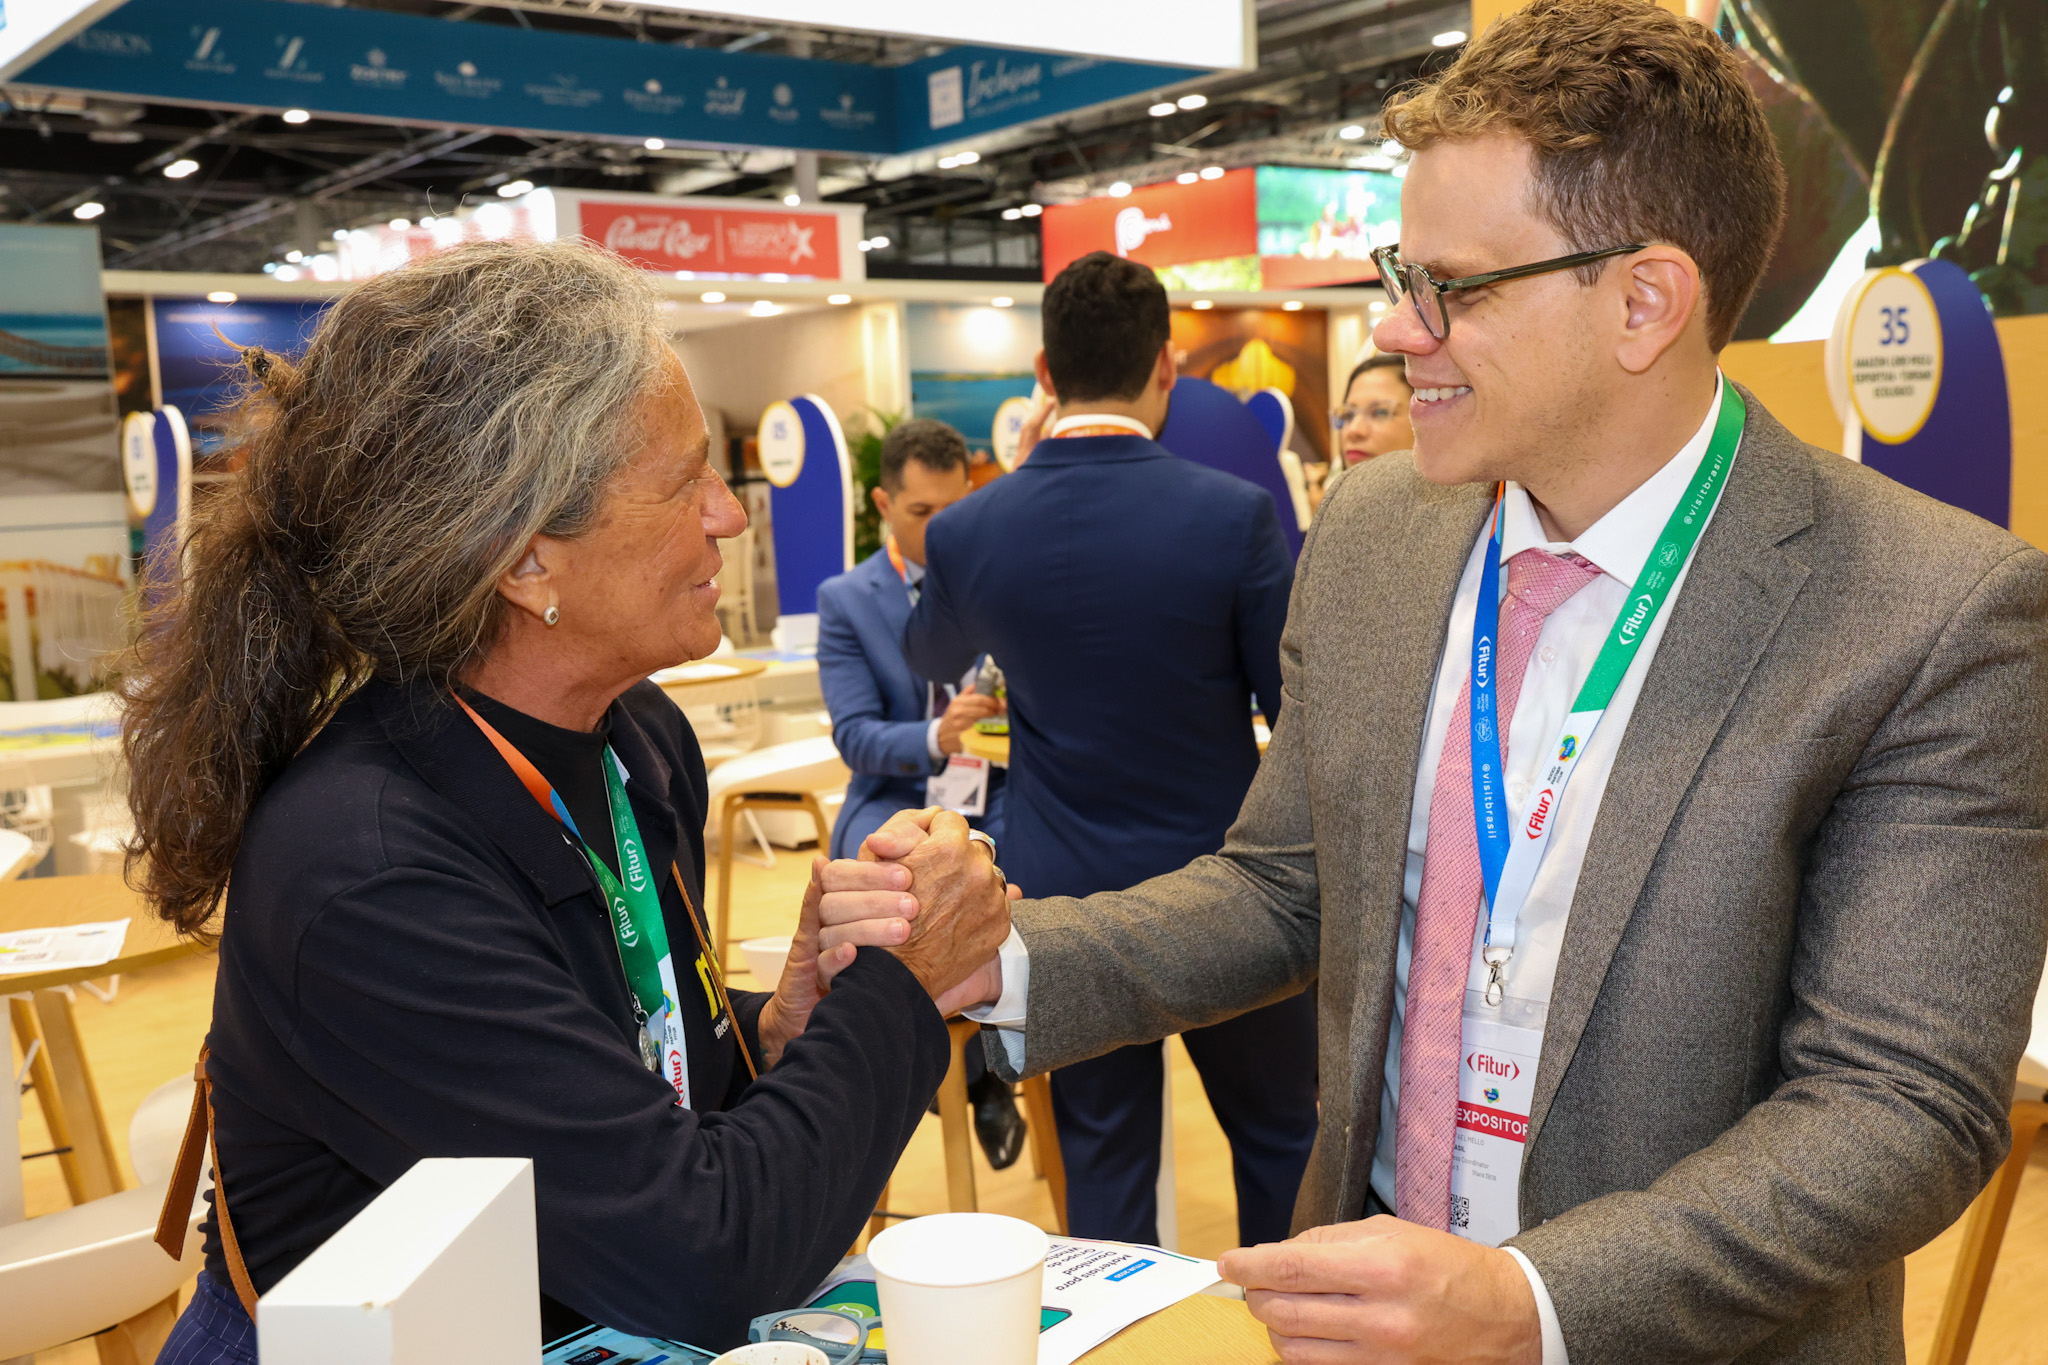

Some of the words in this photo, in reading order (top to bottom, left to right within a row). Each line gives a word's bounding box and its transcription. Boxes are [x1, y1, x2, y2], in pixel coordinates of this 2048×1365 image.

[1880, 307, 1909, 345] 35
[1683, 454, 1724, 525] @visitbrasil
[1564, 741, 1574, 756] BRASIL
[1551, 766, 1562, 785] PARTNER
[1482, 763, 1498, 839] @visitbrasil
[1468, 1135, 1485, 1147] MELLO
[1461, 1156, 1490, 1170] Coordinator
[1472, 1170, 1485, 1179] Stand
[1061, 1251, 1117, 1276] Download
[1064, 1248, 1096, 1264] Grupo
[1081, 1254, 1133, 1280] Materiais
[1055, 1275, 1082, 1292] para
